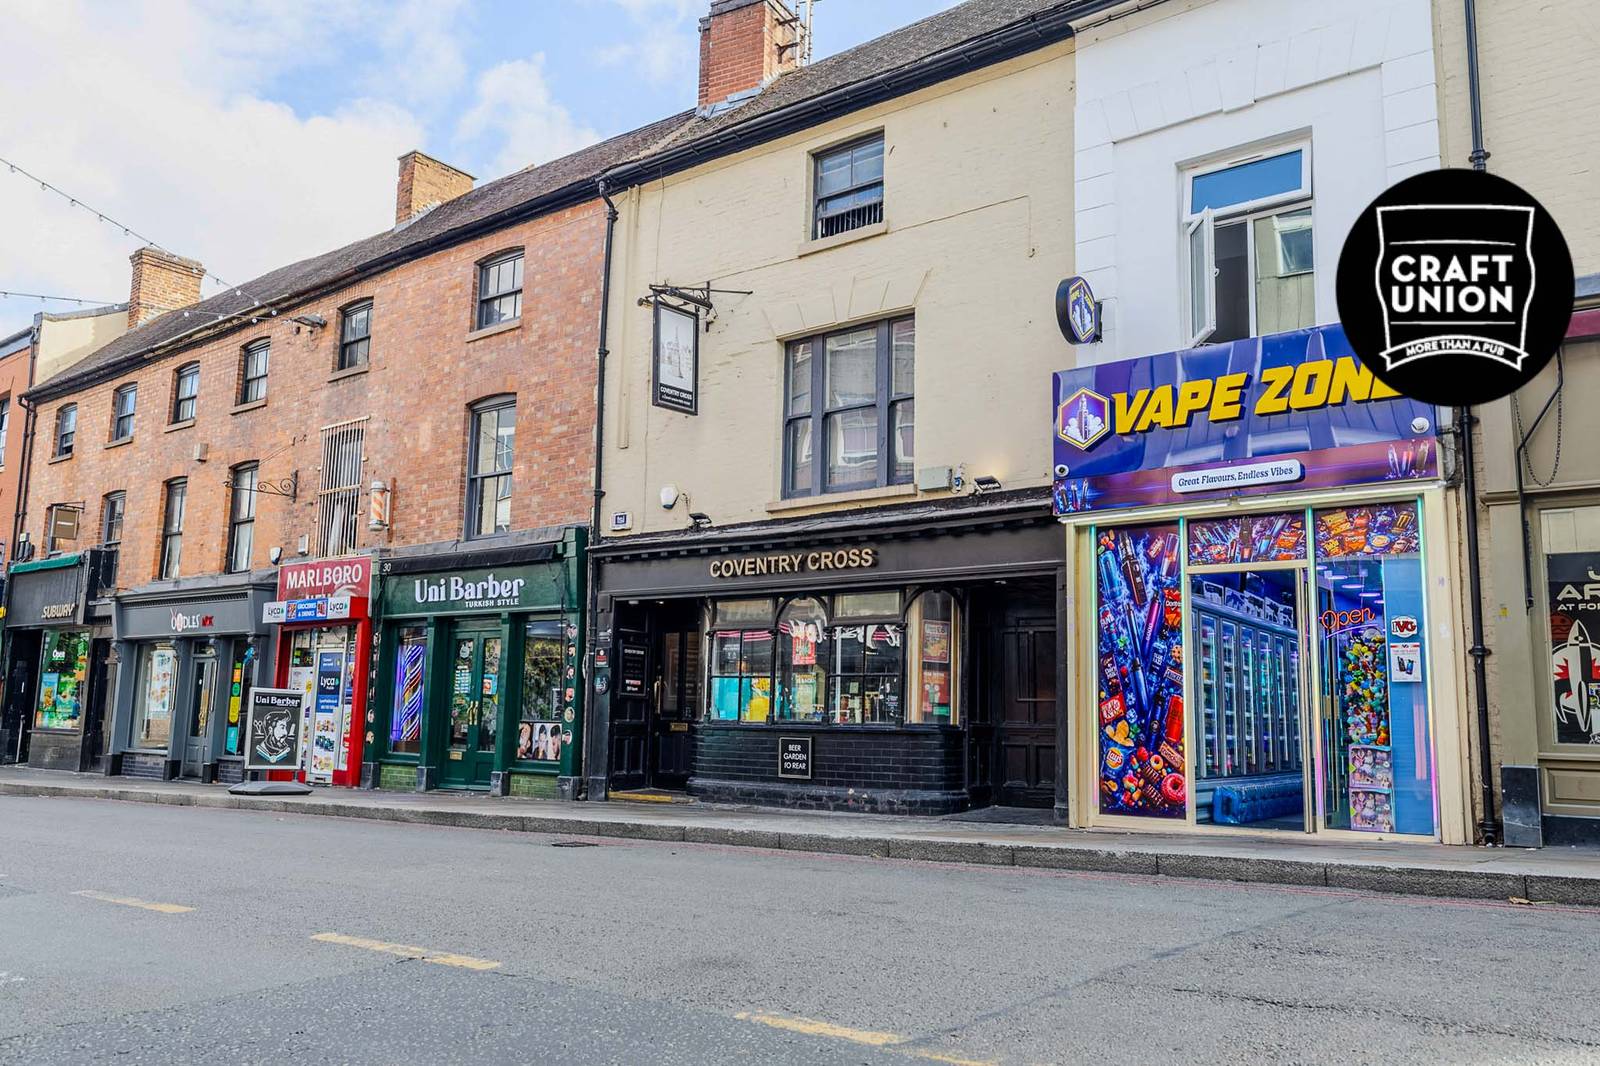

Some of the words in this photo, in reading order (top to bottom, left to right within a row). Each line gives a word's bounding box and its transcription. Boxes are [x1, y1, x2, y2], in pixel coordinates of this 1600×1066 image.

[1112, 372, 1248, 434] VAPE
[1178, 476, 1200, 488] Great
[1201, 472, 1237, 486] Flavours,
[1237, 470, 1269, 482] Endless
[1270, 466, 1293, 477] Vibes
[383, 563, 392, 572] 30
[710, 554, 802, 578] COVENTRY
[807, 549, 873, 571] CROSS
[287, 563, 363, 590] MARLBORO
[415, 578, 446, 603] Uni
[449, 573, 525, 600] Barber
[465, 599, 494, 608] TURKISH
[497, 598, 519, 606] STYLE
[41, 603, 75, 618] SUBWAY
[1321, 608, 1375, 630] Open
[320, 676, 336, 688] Lyca
[255, 696, 270, 704] Uni
[272, 696, 300, 706] Barber
[788, 744, 802, 752] BEER
[783, 752, 807, 761] GARDEN
[784, 761, 791, 769] TO
[792, 762, 807, 770] REAR
